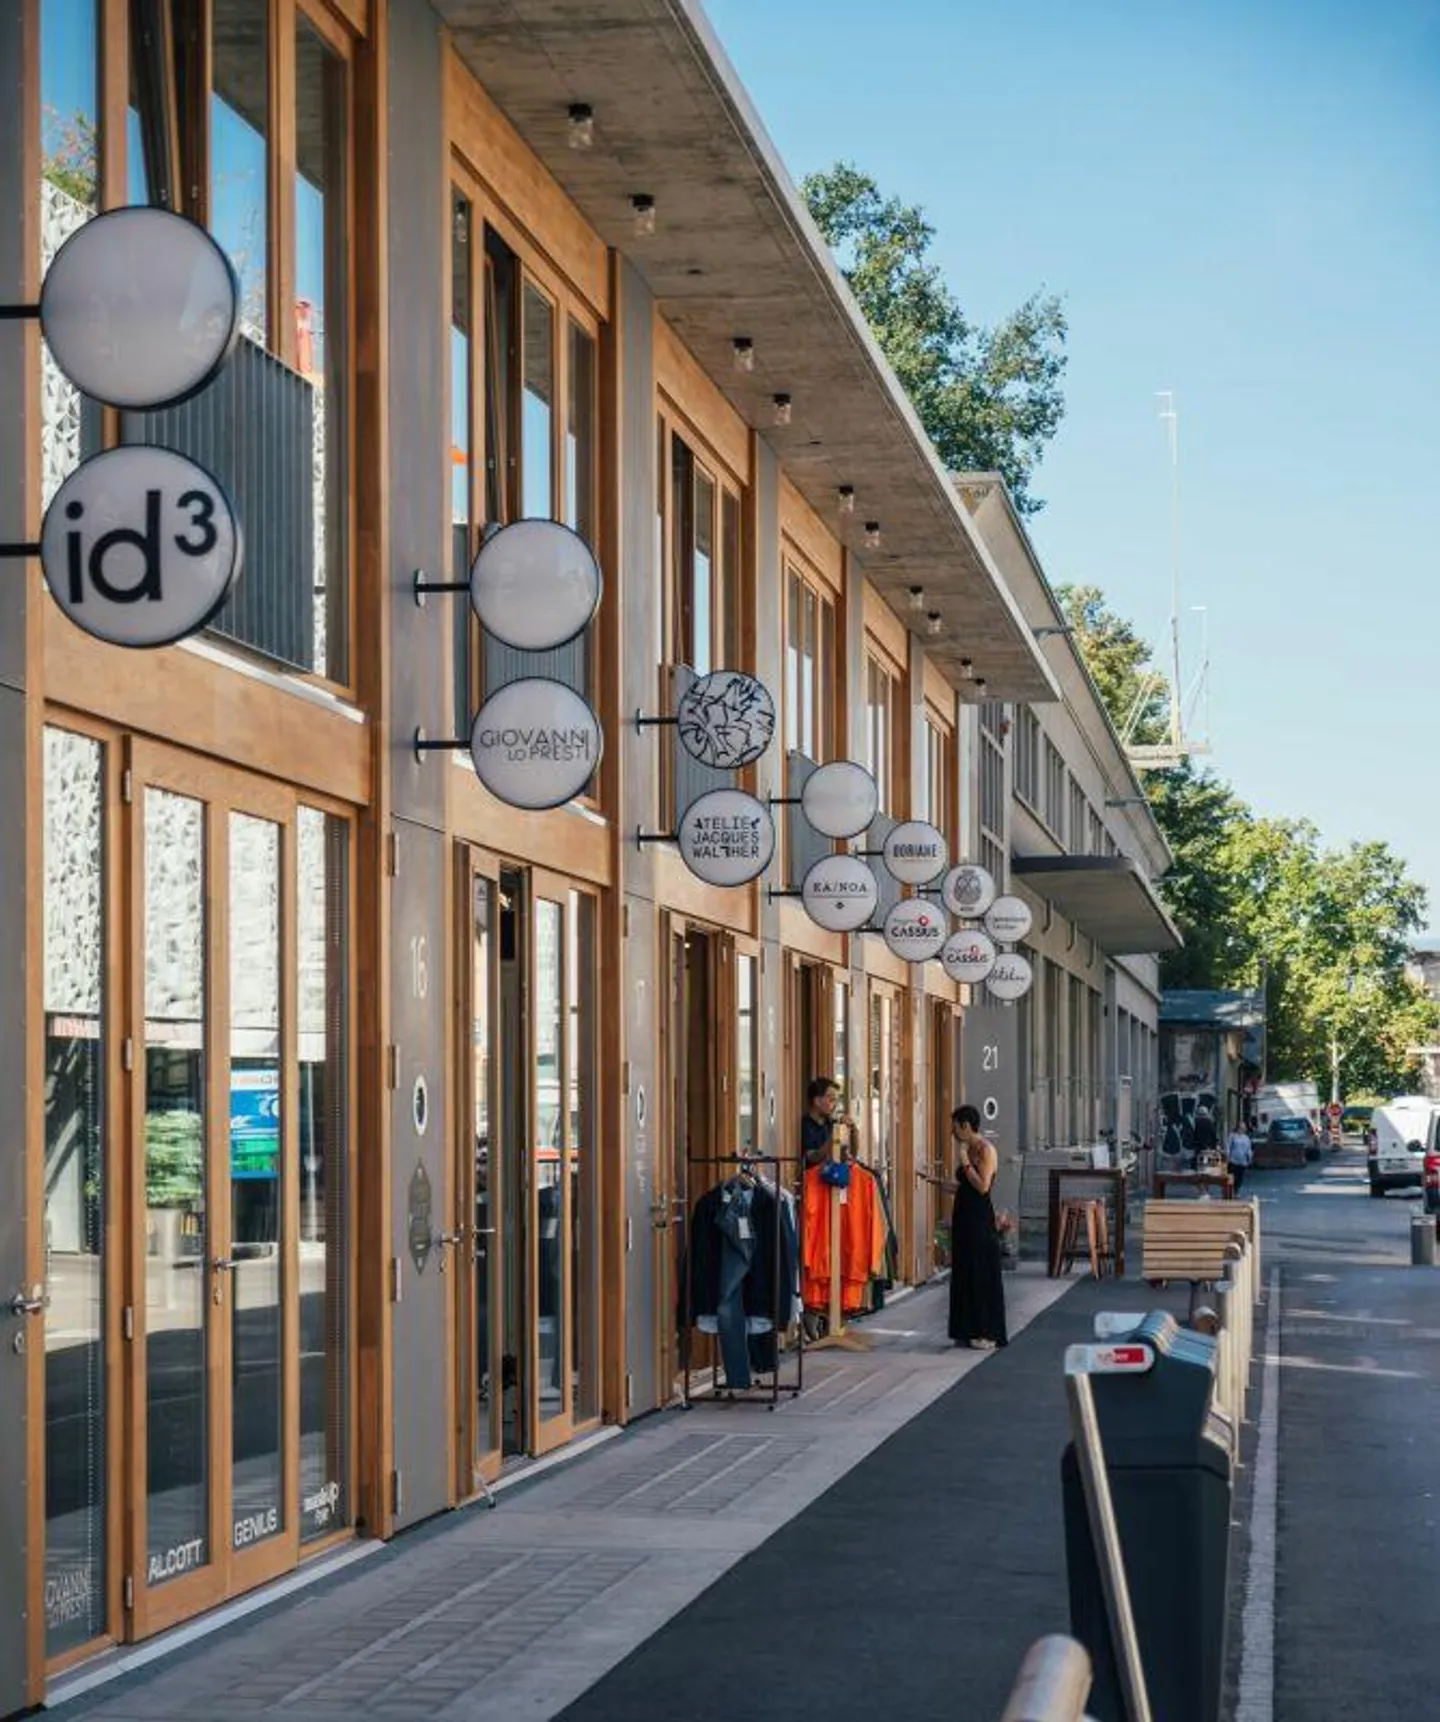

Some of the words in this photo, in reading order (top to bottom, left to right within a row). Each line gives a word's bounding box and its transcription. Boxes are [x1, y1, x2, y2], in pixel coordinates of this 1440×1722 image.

[480, 728, 588, 749] GIOVANNI
[529, 743, 588, 761] PRESTI
[692, 830, 759, 845] JACQUES
[692, 845, 759, 859] WALTHER
[410, 935, 428, 1000] 16
[982, 1045, 999, 1070] 21
[148, 1538, 202, 1582] ALCOTT
